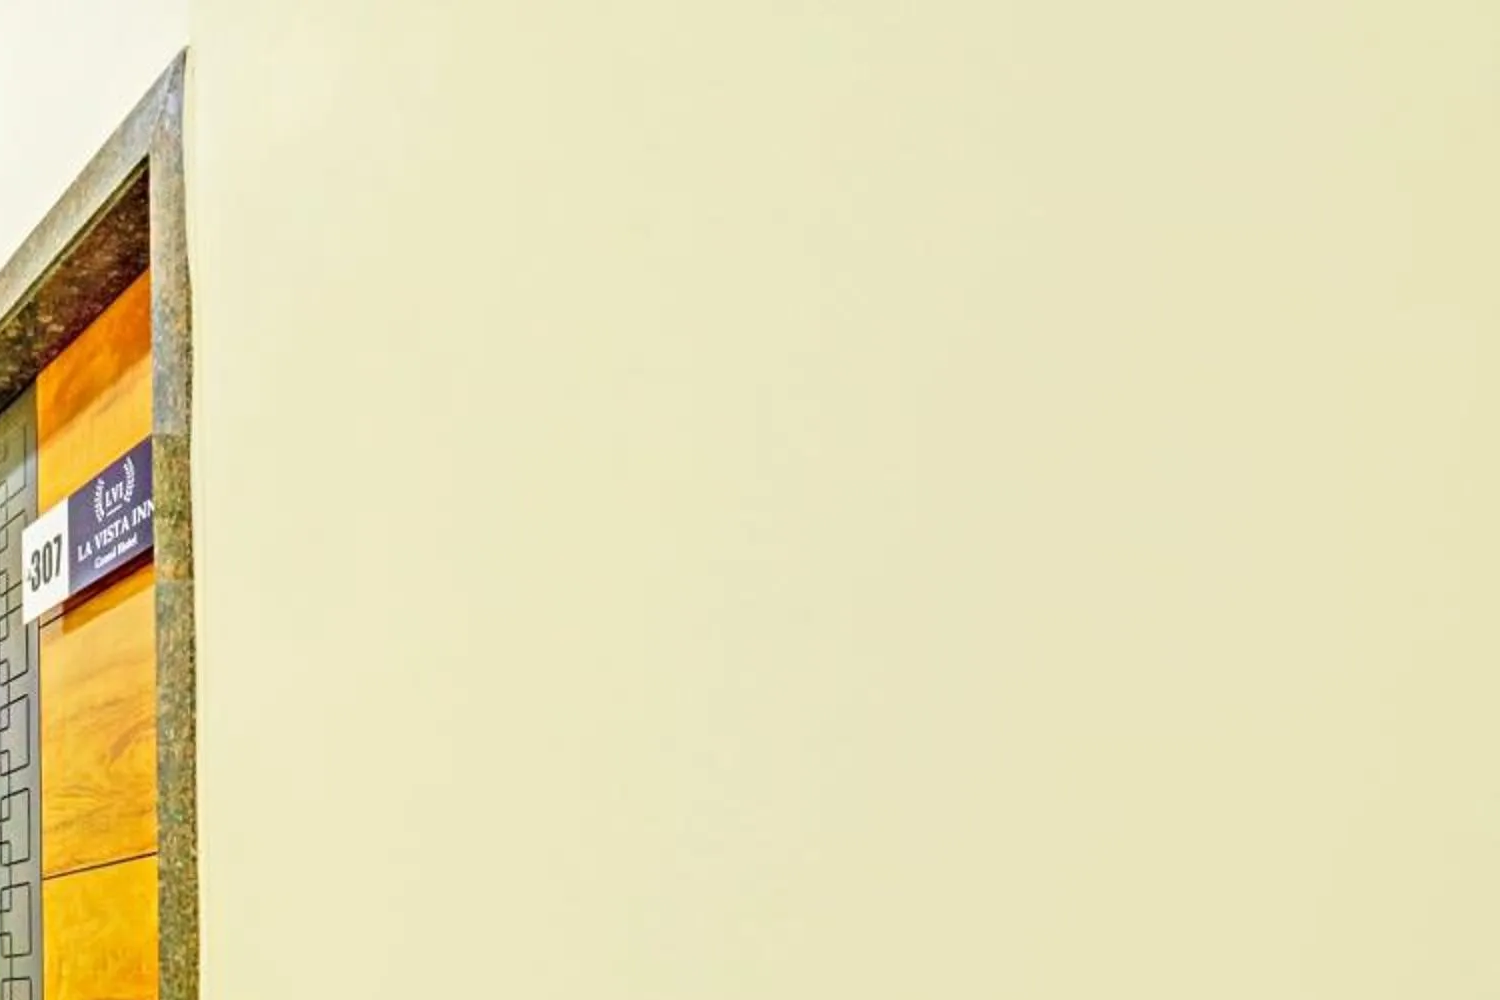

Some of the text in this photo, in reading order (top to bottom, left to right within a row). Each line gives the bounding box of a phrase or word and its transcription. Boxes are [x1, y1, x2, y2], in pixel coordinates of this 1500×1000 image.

[105, 481, 123, 508] LVI
[78, 499, 155, 562] LA VISTA INN
[31, 533, 62, 592] 307
